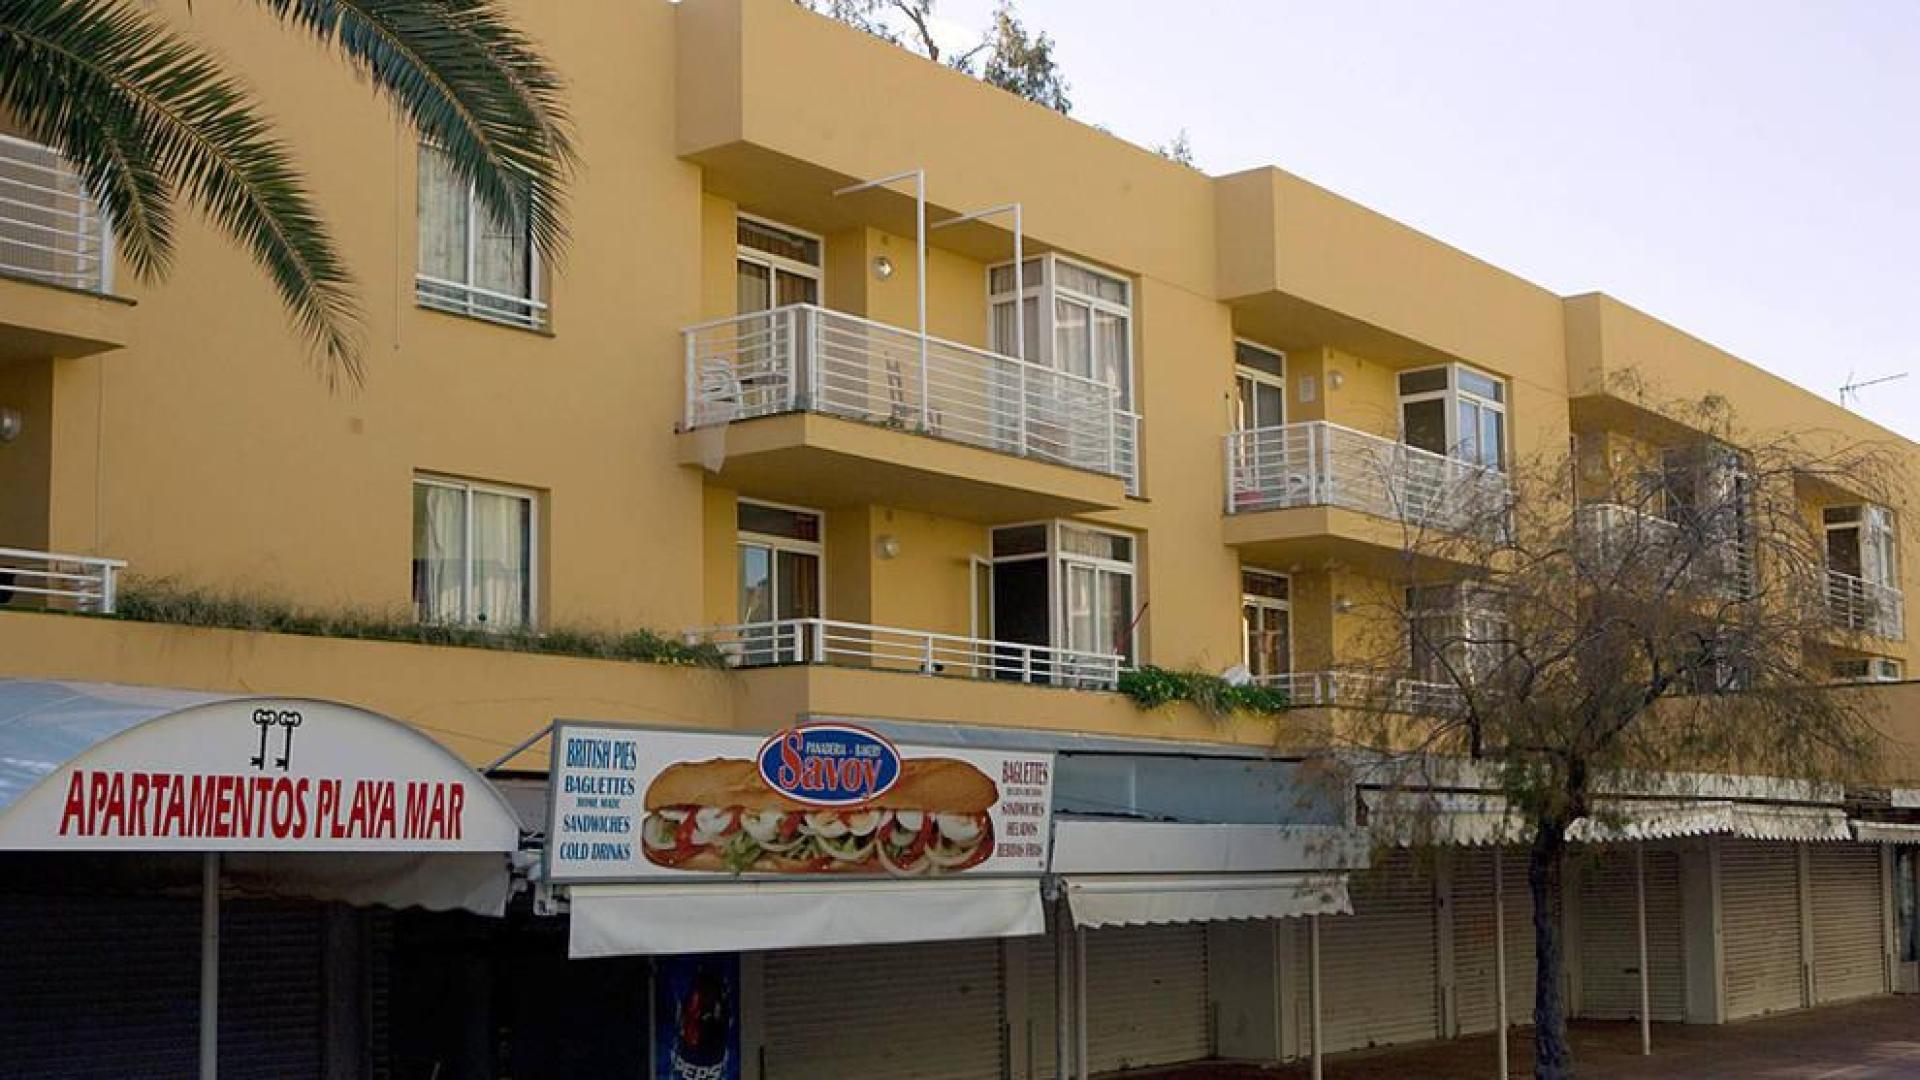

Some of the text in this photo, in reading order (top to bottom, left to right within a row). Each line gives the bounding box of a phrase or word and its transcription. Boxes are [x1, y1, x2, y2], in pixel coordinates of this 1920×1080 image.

[566, 738, 637, 770] BRITISH PIES
[778, 729, 882, 799] Savoy
[564, 775, 635, 795] BAGUETTES
[59, 770, 465, 840] APARTAMENTOS PLAYA MAR
[563, 814, 631, 833] SANDWICHES
[560, 842, 631, 860] COLD DRINKS
